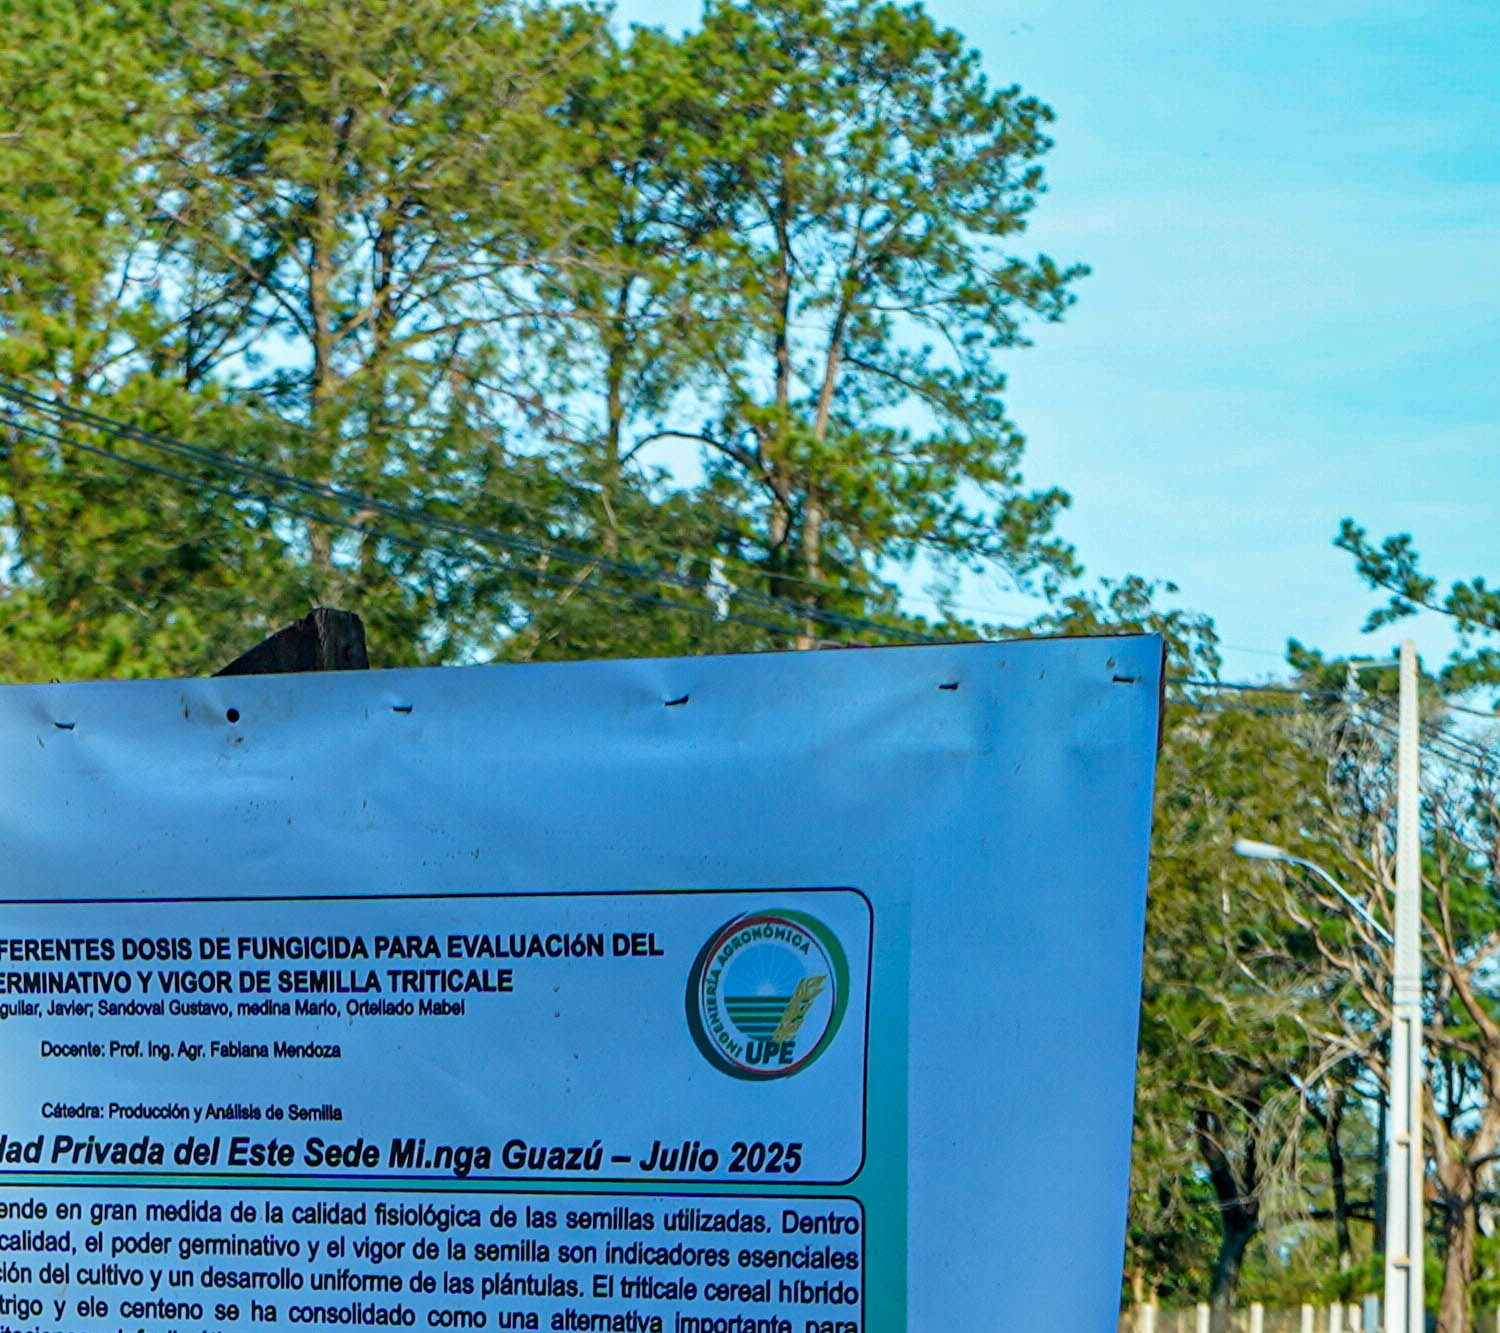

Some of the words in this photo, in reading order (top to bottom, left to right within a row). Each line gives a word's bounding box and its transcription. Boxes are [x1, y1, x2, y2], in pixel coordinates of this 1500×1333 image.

[122, 938, 192, 960] DOSIS
[200, 937, 231, 959] DE
[238, 936, 369, 959] FUNGICIDA
[375, 936, 441, 958] PARA
[613, 933, 664, 956] DEL
[137, 971, 152, 993] Y
[158, 971, 232, 993] VIGOR
[240, 971, 271, 993] DE
[278, 970, 381, 992] SEMILLA
[387, 969, 513, 992] TRITICALE
[41, 1040, 105, 1057] Docente:
[110, 1040, 143, 1057] Prof.
[148, 1041, 174, 1061] Ing.
[178, 1041, 205, 1061] Agr.
[211, 1041, 268, 1058] Fabiana
[274, 1041, 341, 1058] Mendoza
[745, 1041, 796, 1065] UPE
[41, 1102, 104, 1118] Cátedra:
[109, 1102, 189, 1119] Producción
[194, 1107, 202, 1123] y
[205, 1103, 261, 1120] Análisis
[265, 1104, 284, 1120] de
[288, 1104, 342, 1121] Semilla
[51, 1135, 162, 1166] Privada
[173, 1136, 219, 1166] del
[228, 1137, 295, 1167] Este
[304, 1137, 379, 1168] Sede
[503, 1139, 603, 1170] Guazú
[640, 1140, 718, 1171] Julio
[729, 1142, 802, 1173] 2025
[56, 1203, 81, 1220] en
[91, 1203, 136, 1225] gran
[146, 1200, 221, 1222] medida
[231, 1201, 256, 1222] de
[266, 1201, 283, 1223] la
[292, 1202, 366, 1225] calidad
[375, 1203, 480, 1232] fisiológica
[490, 1205, 517, 1227] de
[526, 1206, 557, 1228] las
[566, 1207, 654, 1230] semillas
[664, 1209, 771, 1233] utilizadas.
[782, 1210, 859, 1234] Dentro
